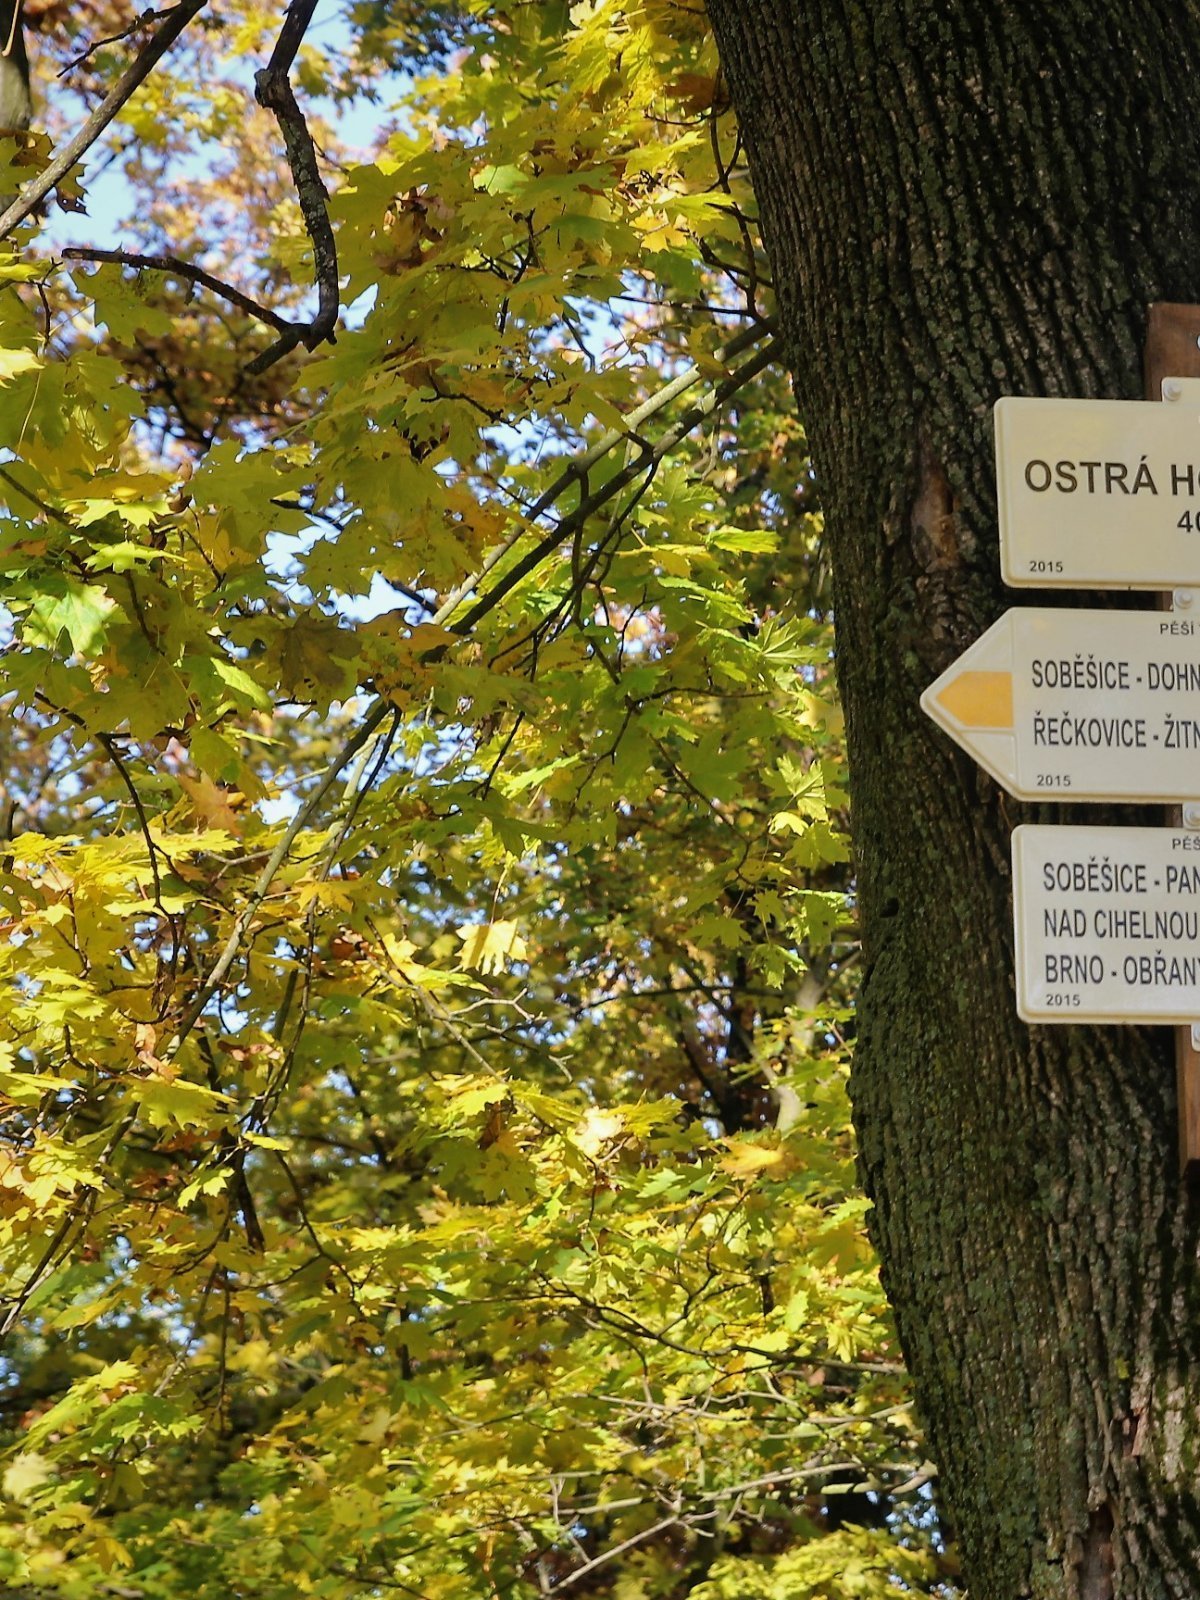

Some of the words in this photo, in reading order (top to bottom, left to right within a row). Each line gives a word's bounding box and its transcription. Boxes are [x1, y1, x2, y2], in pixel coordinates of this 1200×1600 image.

[1024, 455, 1158, 495] OSTRÁ
[1029, 560, 1063, 573] 2015
[1160, 620, 1194, 636] PĚŠÍ
[1031, 653, 1130, 690] SOBĚŠICE
[1033, 710, 1147, 748] ŘEČKOVICE
[1037, 774, 1071, 787] 2015
[1043, 855, 1148, 893] SOBĚŠICE
[1044, 908, 1087, 938] NAD
[1094, 909, 1198, 940] CIHELNOU
[1045, 955, 1104, 984] BRNO
[1046, 993, 1081, 1007] 2015
